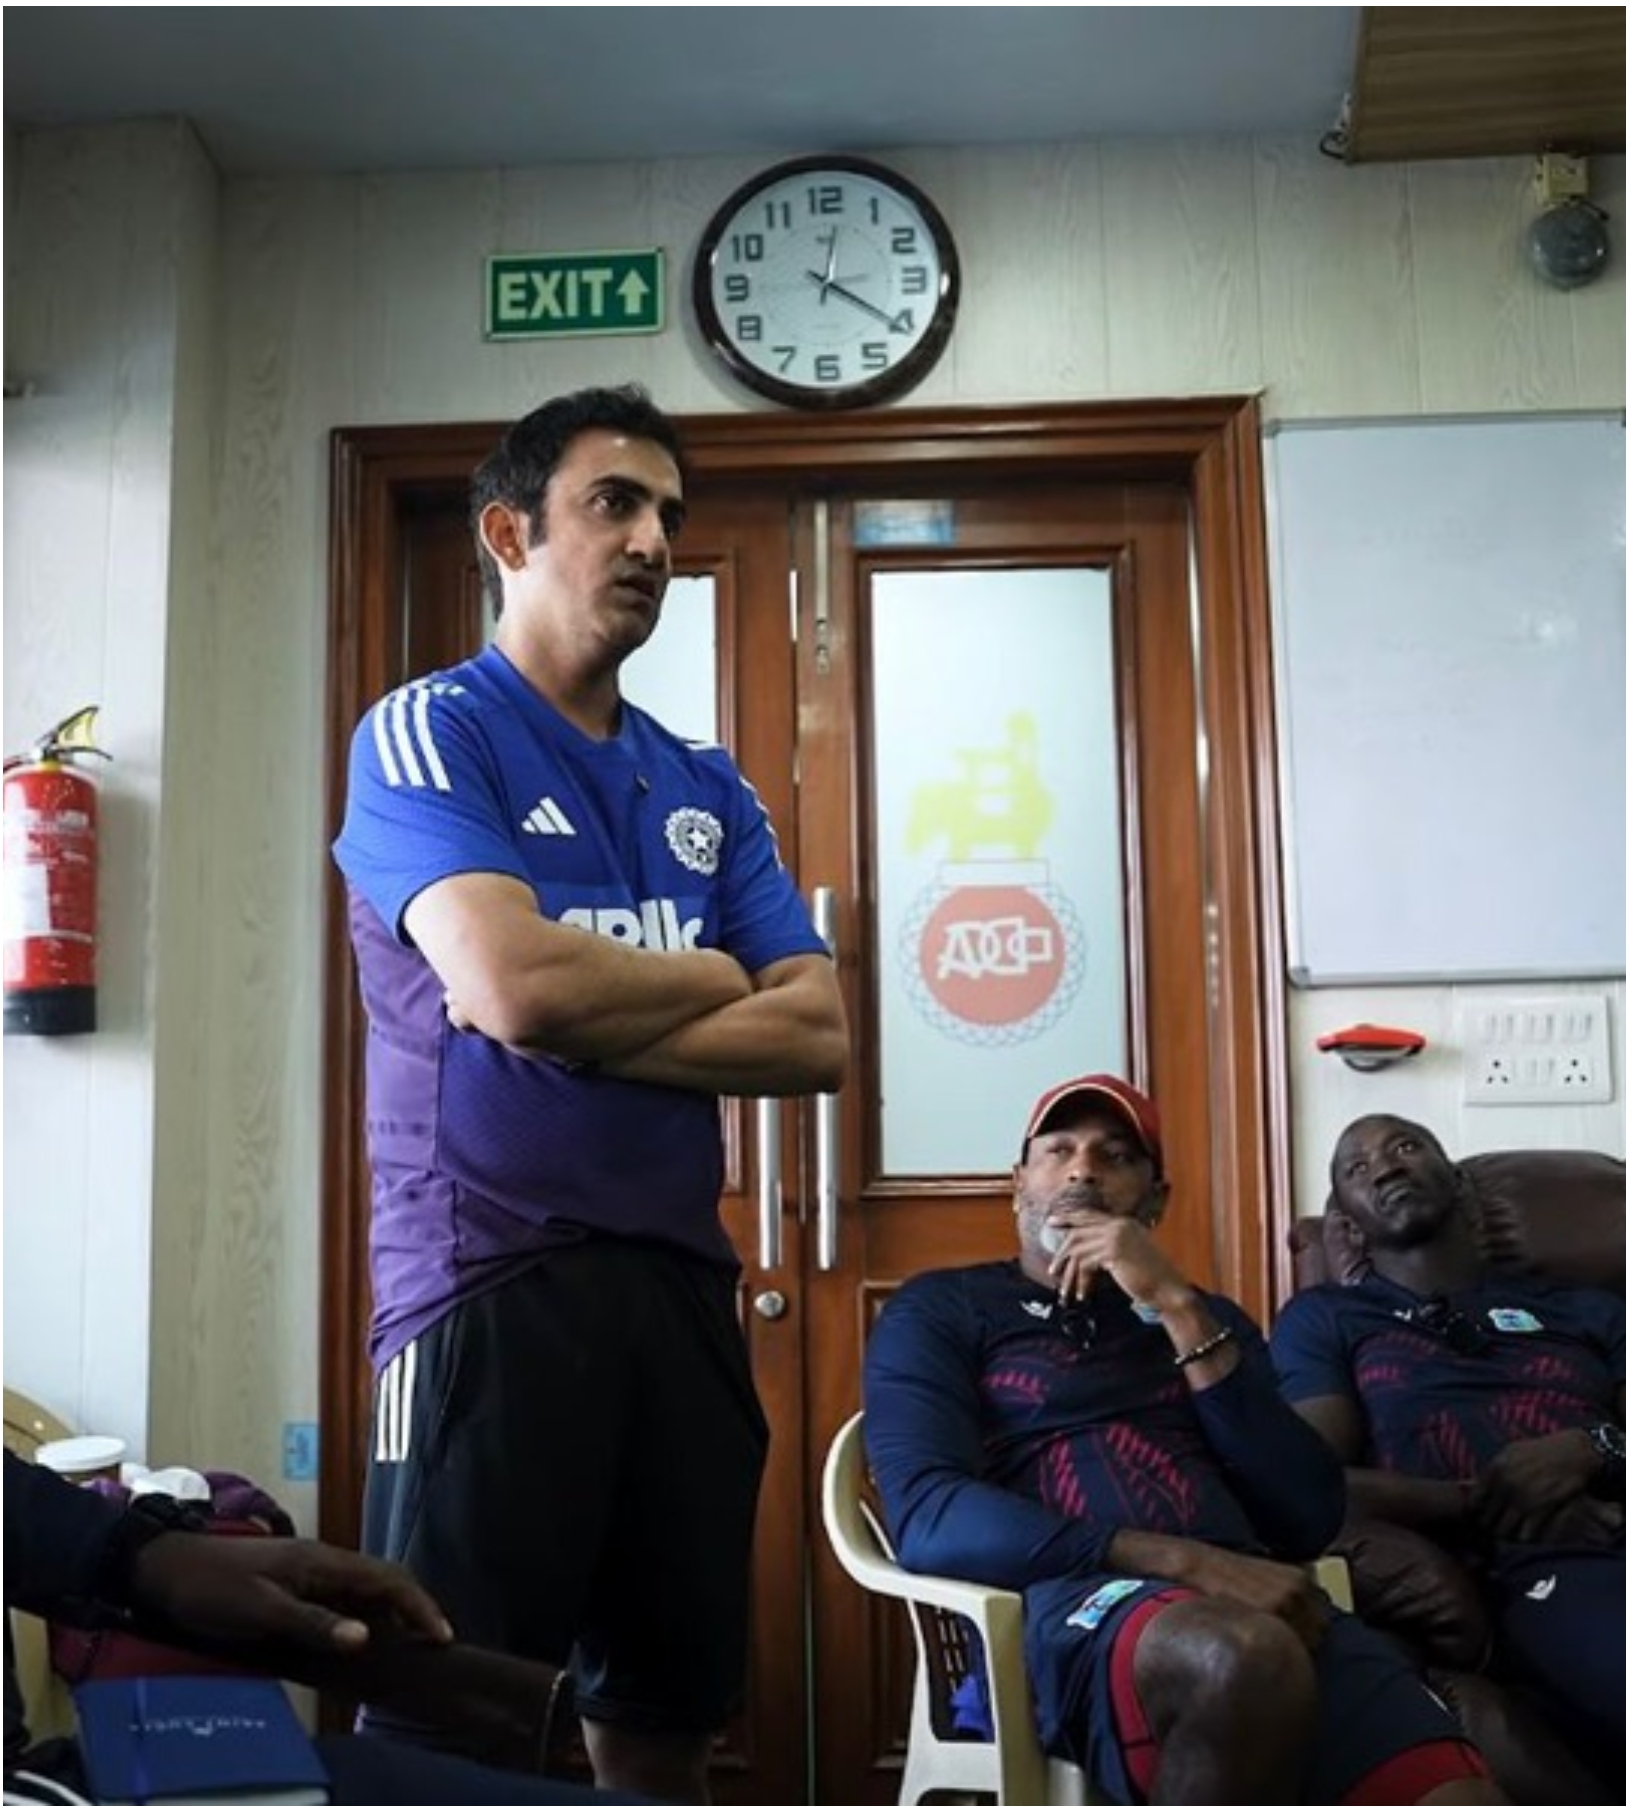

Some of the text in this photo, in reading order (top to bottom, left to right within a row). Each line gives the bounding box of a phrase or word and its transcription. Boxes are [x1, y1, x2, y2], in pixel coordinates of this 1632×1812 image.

[808, 186, 844, 215] 12
[868, 196, 880, 225] 1
[766, 201, 791, 229] 11
[732, 234, 764, 262] 10
[891, 227, 916, 255] 2
[498, 268, 614, 320] EXIT
[725, 274, 750, 303] 9
[902, 266, 927, 295] 3
[737, 314, 763, 342] 8
[771, 345, 797, 372] 7
[813, 354, 840, 380] 6
[860, 341, 888, 370] 5
